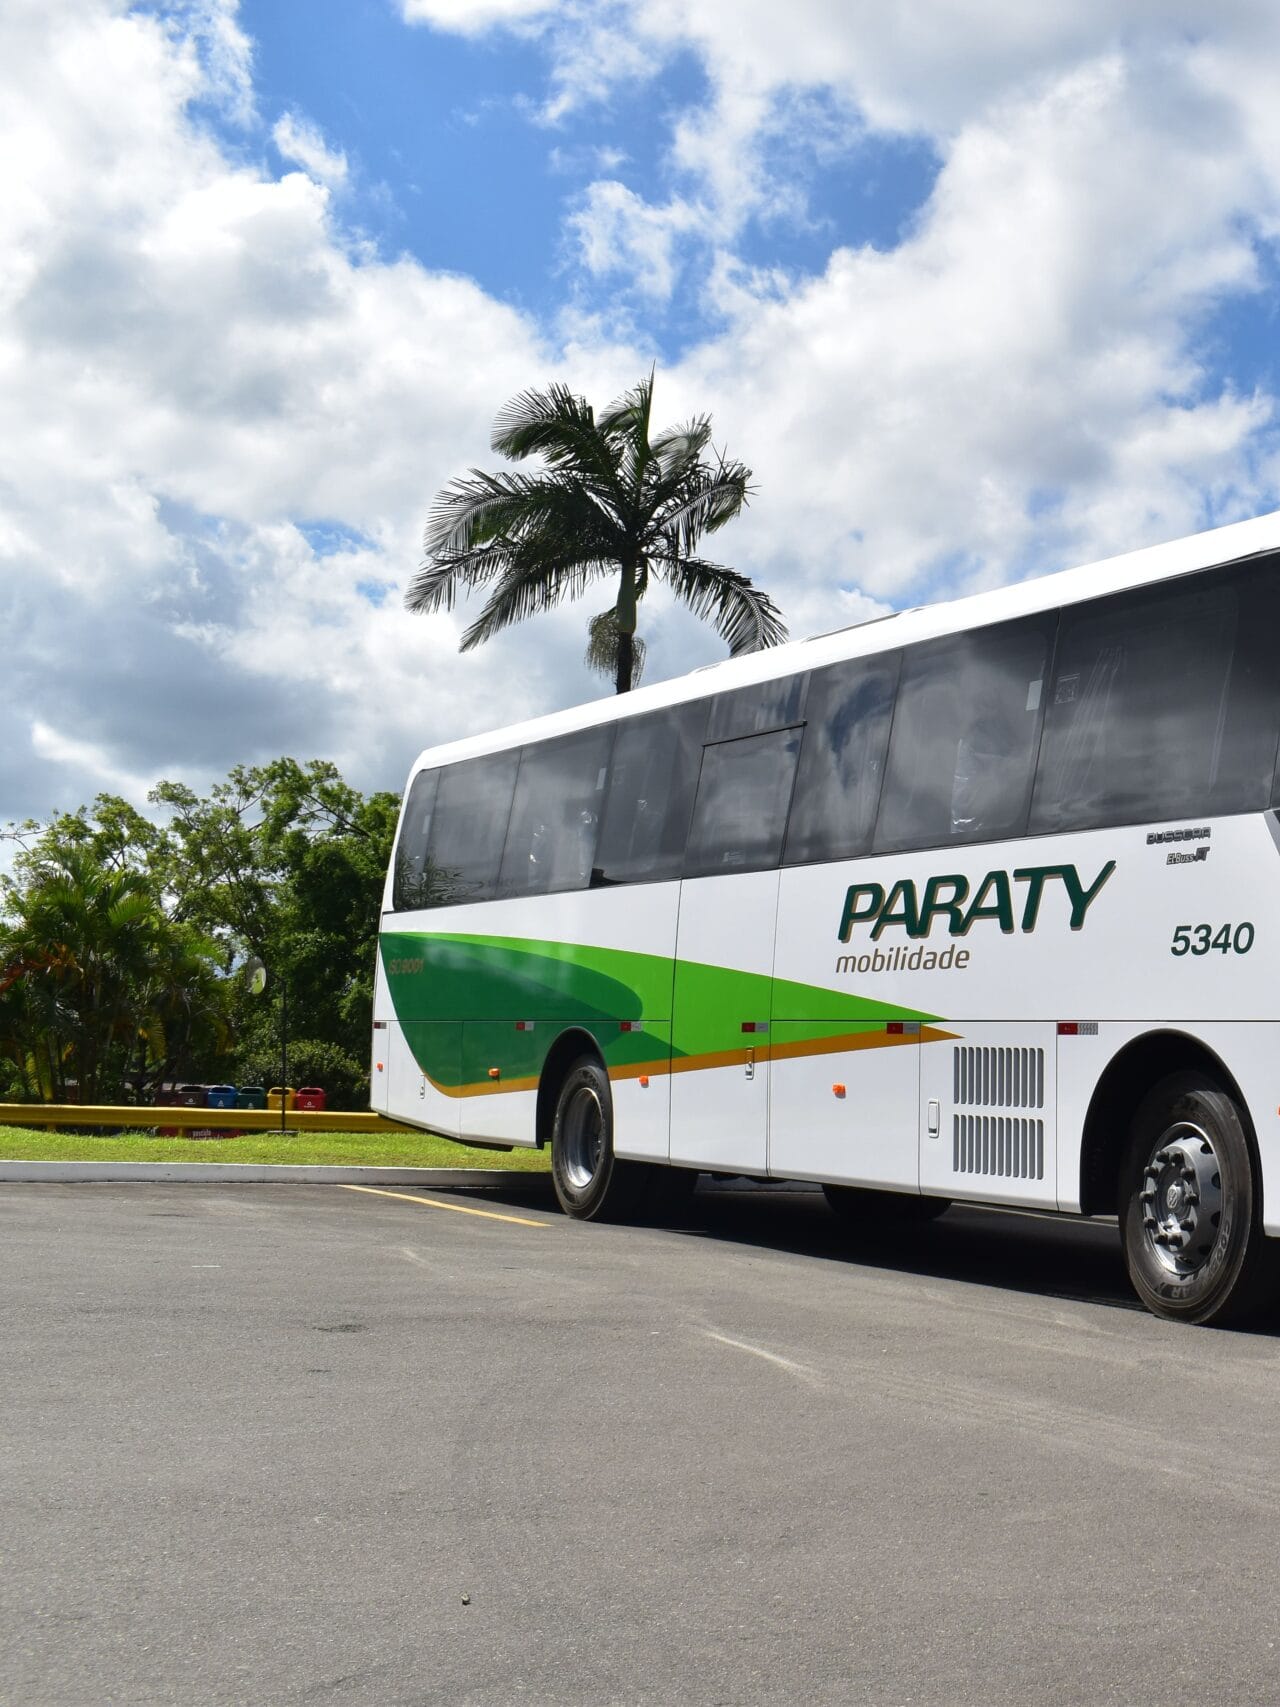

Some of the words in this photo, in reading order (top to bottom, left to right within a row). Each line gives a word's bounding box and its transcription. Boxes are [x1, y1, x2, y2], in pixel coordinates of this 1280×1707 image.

[1146, 827, 1211, 845] BUSSCAR
[838, 860, 1116, 942] PARATY
[1170, 922, 1255, 956] 5340
[836, 944, 970, 973] mobilidade
